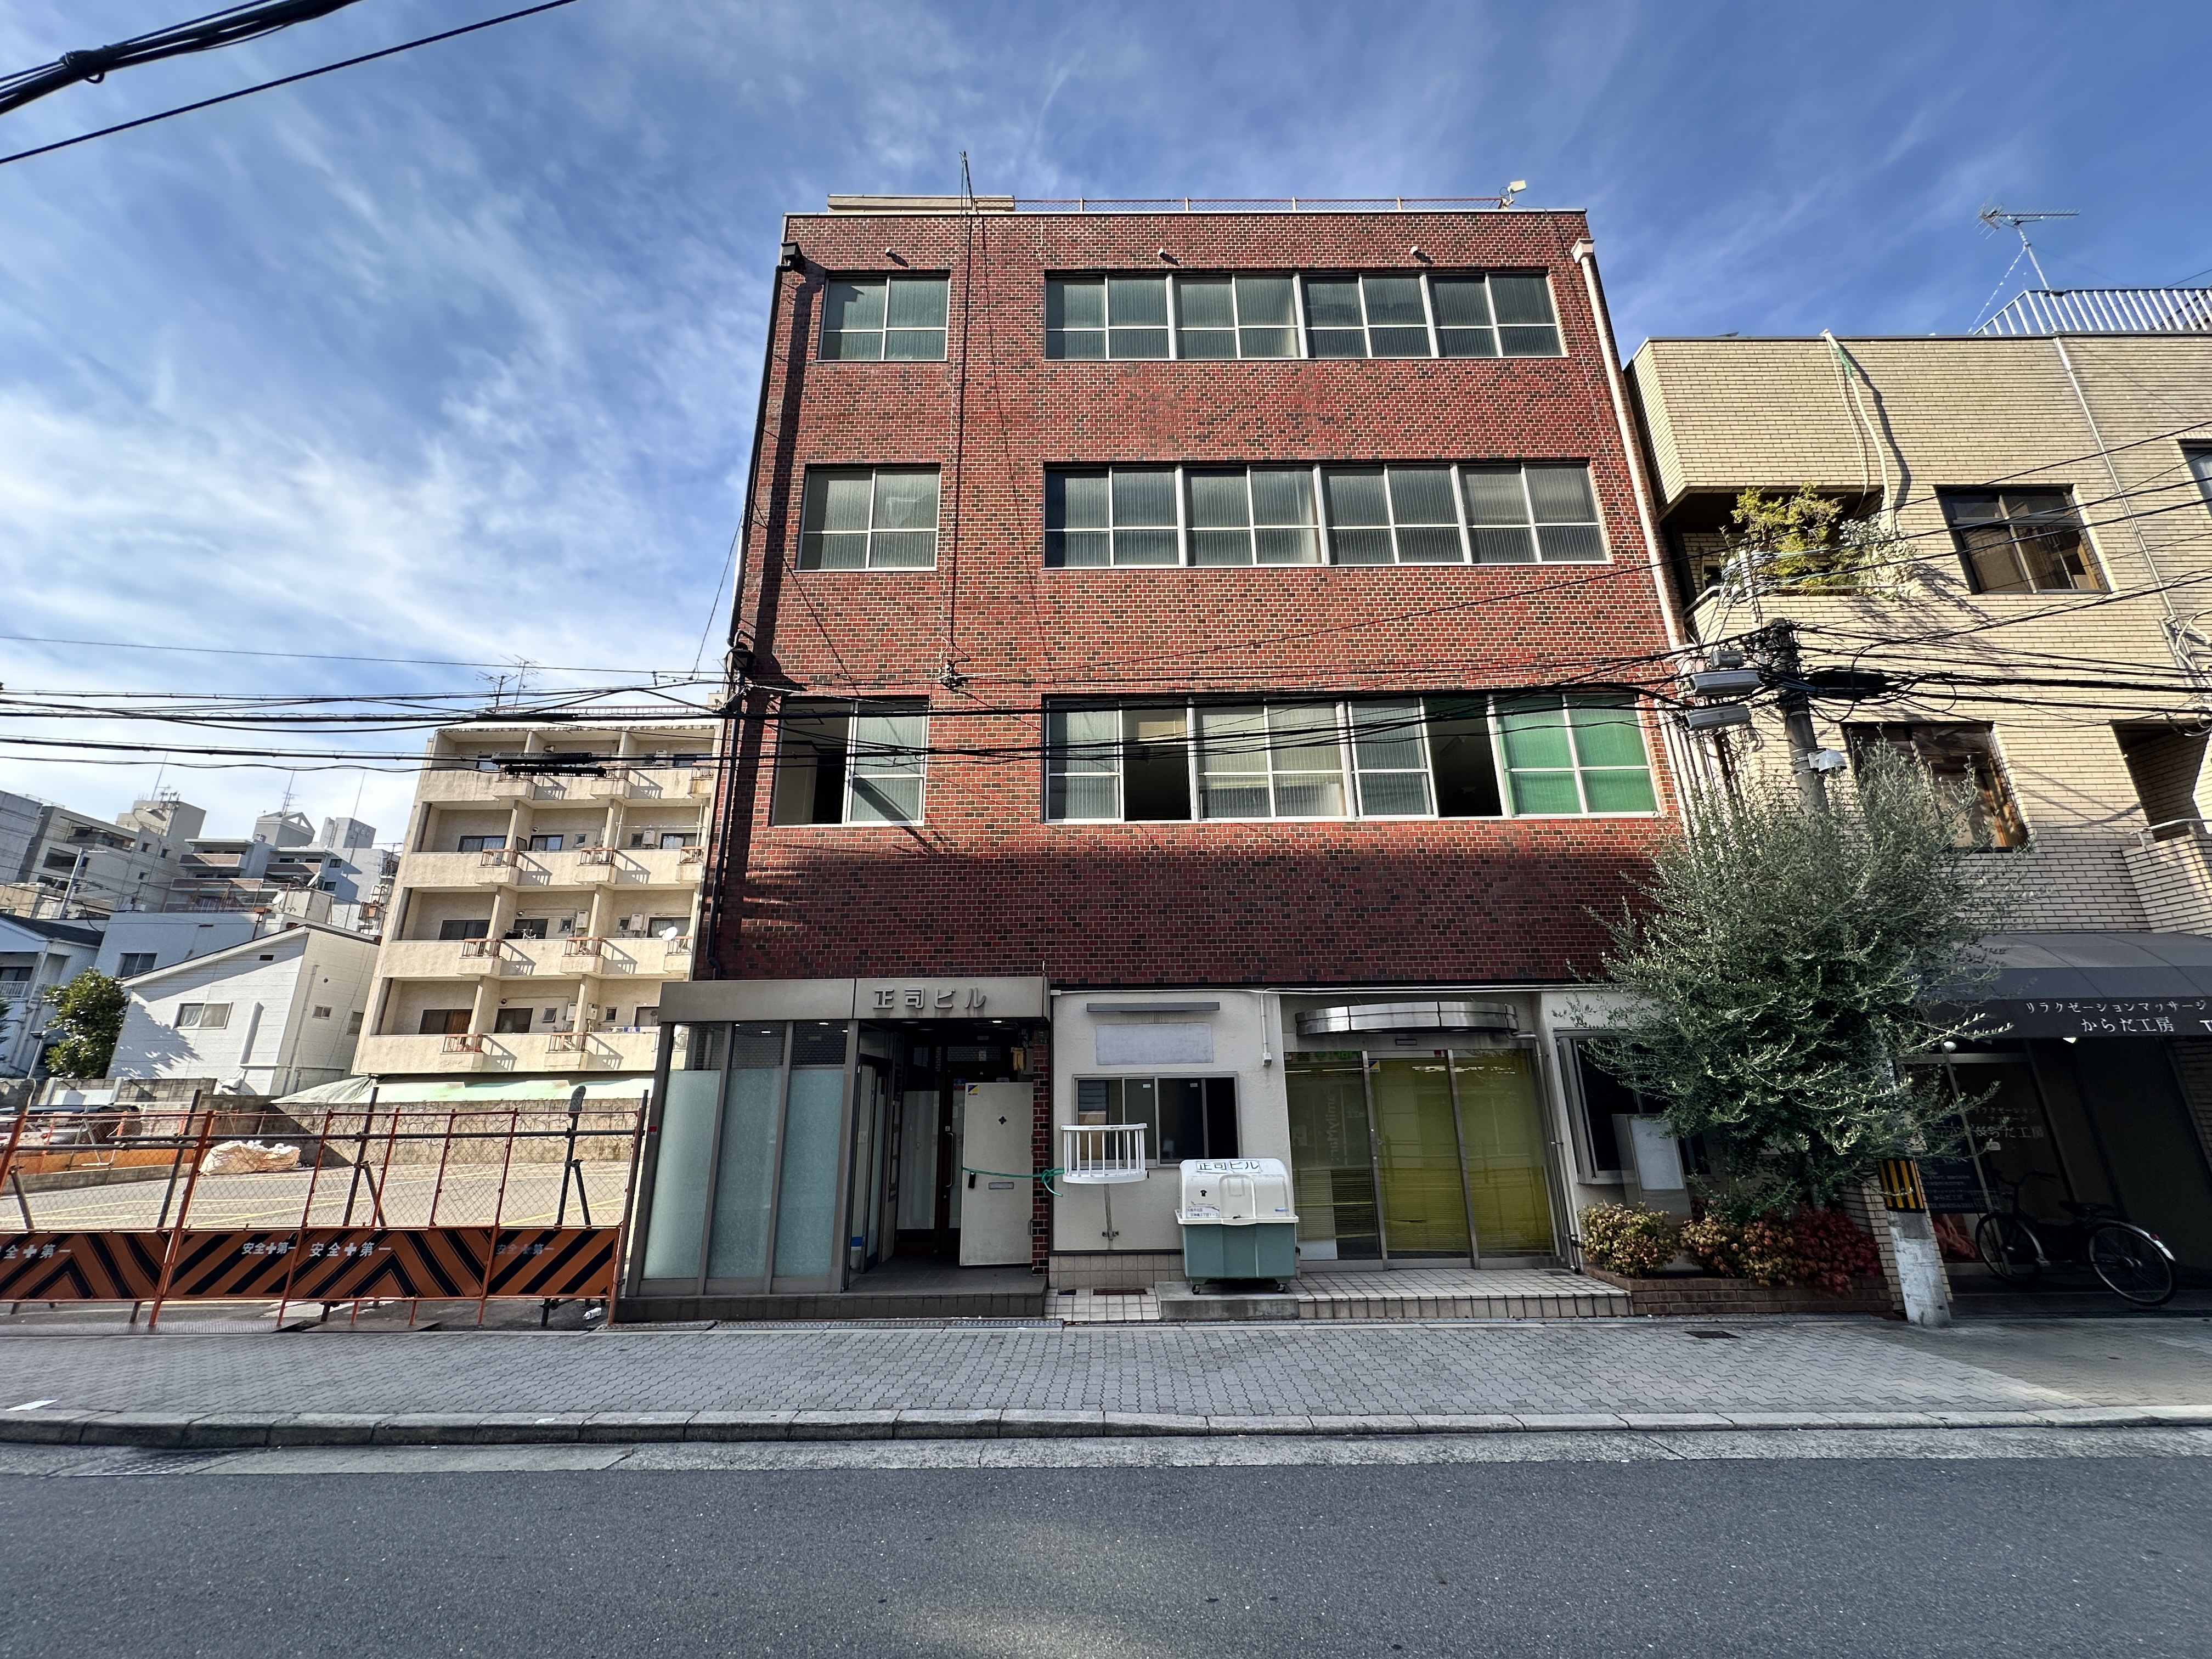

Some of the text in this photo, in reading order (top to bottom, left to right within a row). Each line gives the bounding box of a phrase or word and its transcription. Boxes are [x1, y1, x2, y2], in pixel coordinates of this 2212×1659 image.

[873, 986, 986, 1009] 正司ビル
[2080, 1017, 2212, 1032] からだ工房 T
[1198, 1161, 1259, 1170] 正司ビル
